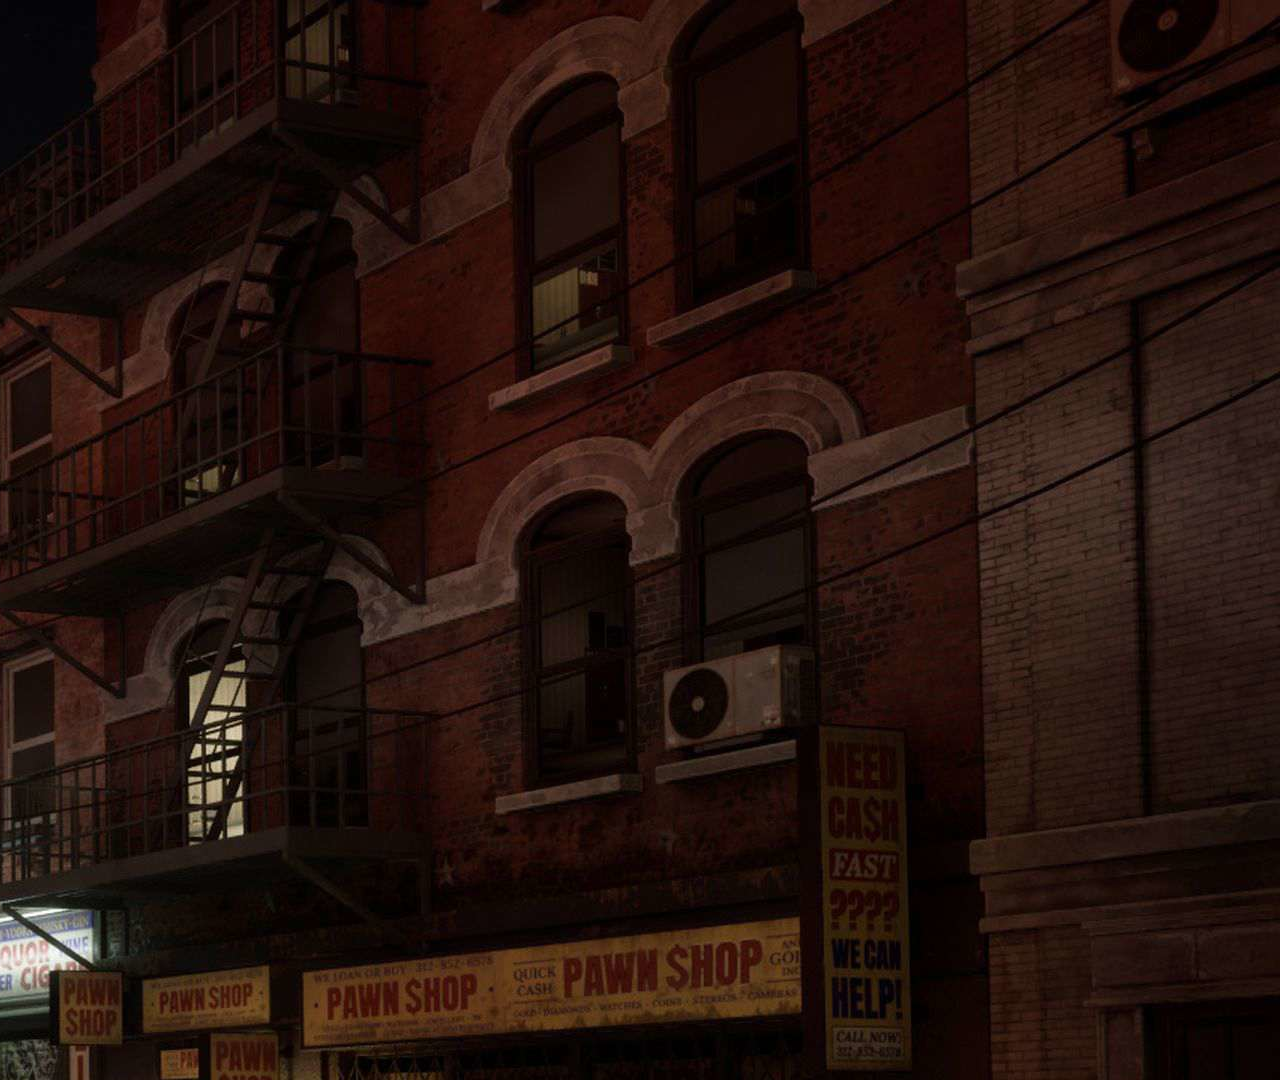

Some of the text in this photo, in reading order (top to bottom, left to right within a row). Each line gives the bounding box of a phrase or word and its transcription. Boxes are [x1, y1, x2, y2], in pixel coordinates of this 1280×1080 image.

[827, 741, 897, 789] NEED
[831, 852, 897, 879] FAST
[831, 939, 902, 970] WE CAN
[513, 966, 556, 982] QUICK
[562, 948, 658, 998] PAWN
[63, 977, 119, 1005] PAWN
[159, 987, 205, 1015] PAWN
[327, 981, 400, 1020] PAWN
[516, 982, 553, 996] CASH
[831, 975, 902, 1020] HELP!
[216, 1039, 276, 1071] PAWN
